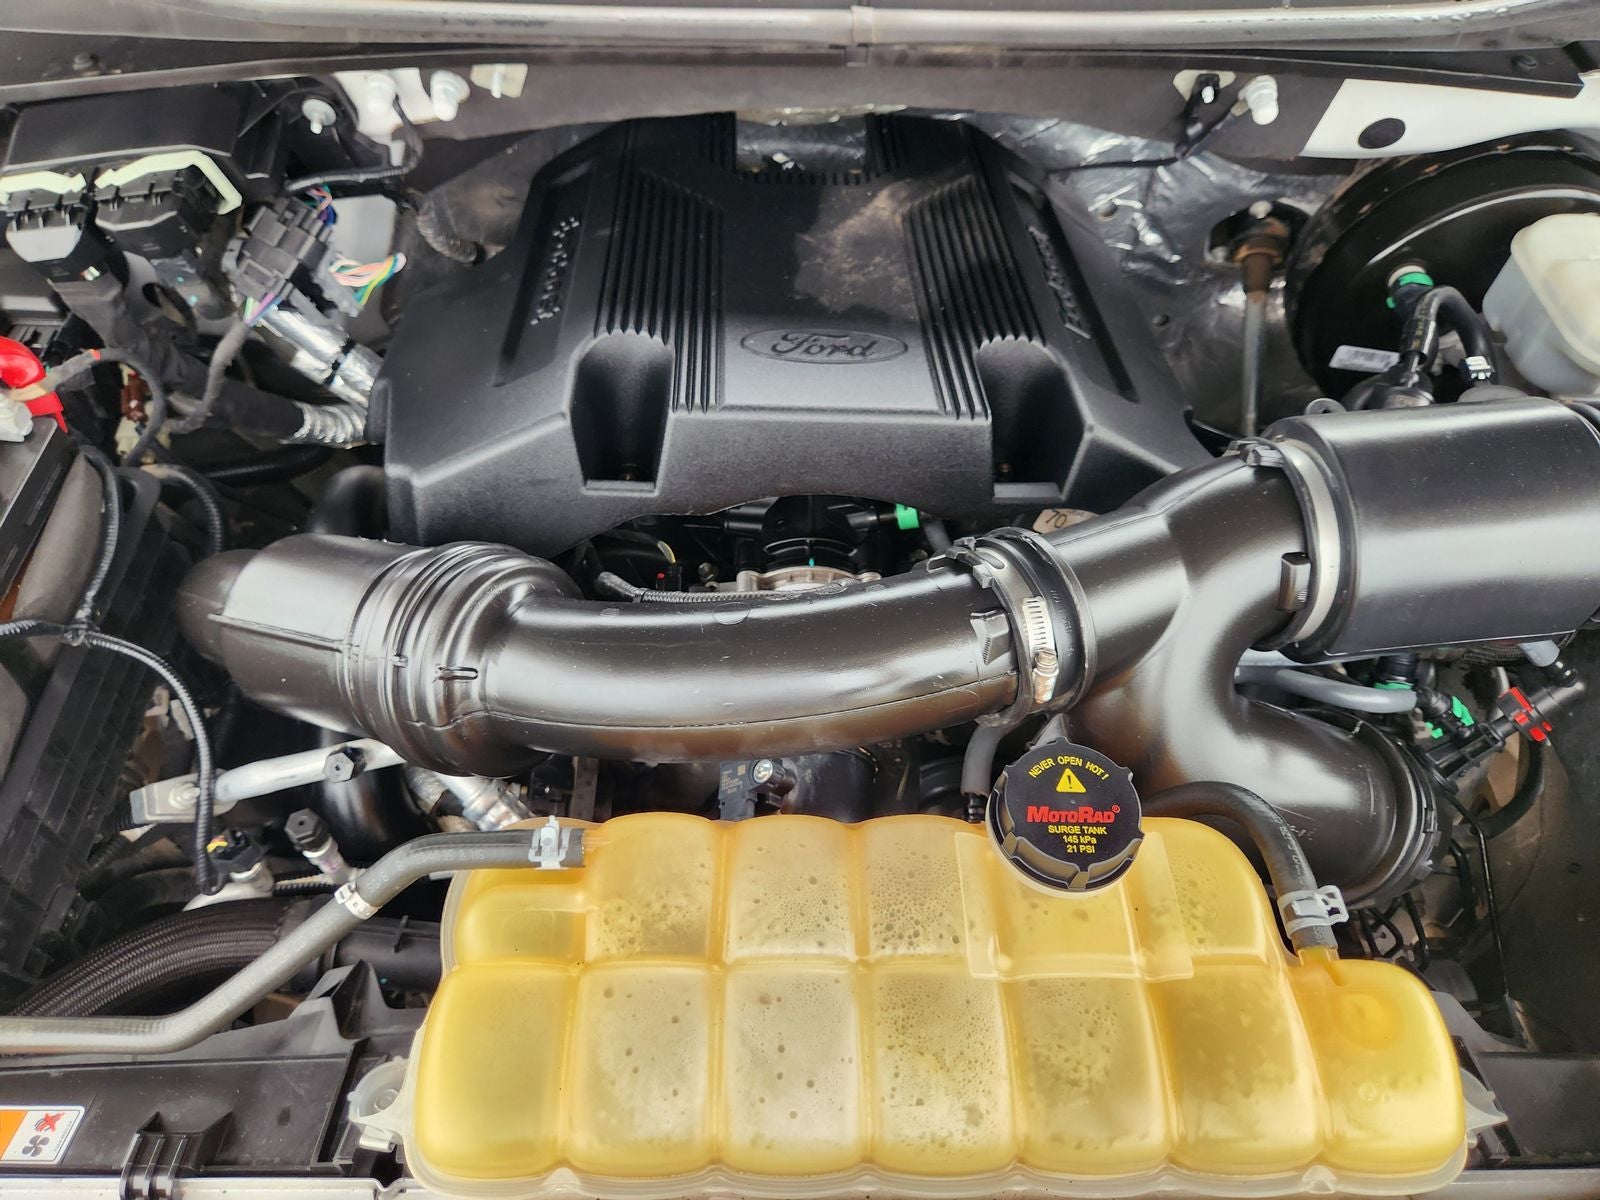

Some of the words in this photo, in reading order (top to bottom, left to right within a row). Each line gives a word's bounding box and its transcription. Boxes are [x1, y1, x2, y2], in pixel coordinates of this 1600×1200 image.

[771, 333, 879, 357] Ford
[1028, 758, 1055, 778] NEVER
[1057, 756, 1083, 767] OPEN
[1085, 762, 1109, 780] HOT!
[1048, 825, 1081, 835] SURGE
[1082, 826, 1108, 835] TANK
[1062, 835, 1079, 844] 145
[1080, 835, 1097, 845] kPa
[1066, 844, 1078, 853] 21
[1079, 845, 1096, 854] PSI
